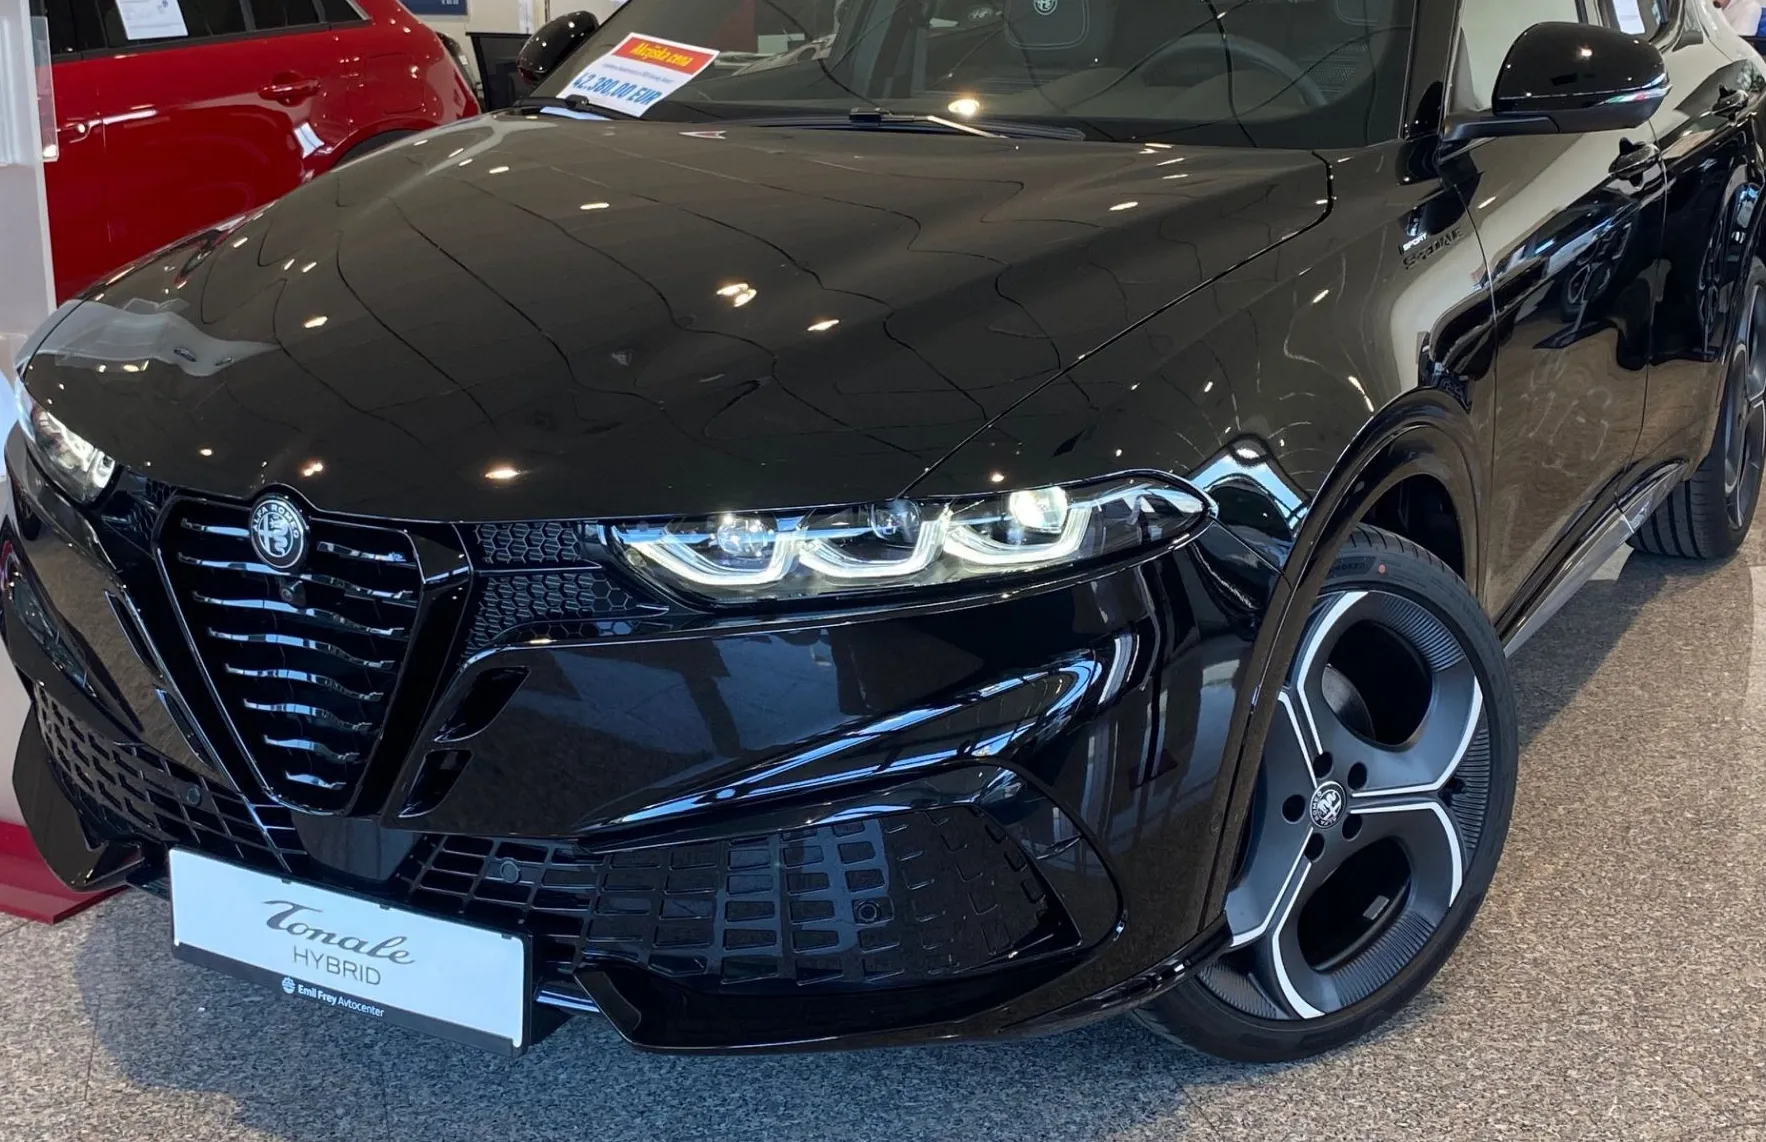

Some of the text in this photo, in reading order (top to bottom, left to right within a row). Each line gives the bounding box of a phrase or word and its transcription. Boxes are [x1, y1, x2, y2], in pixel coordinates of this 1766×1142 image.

[666, 53, 693, 67] cena
[630, 85, 662, 105] EUR
[252, 504, 299, 539] ALFA ROMEO
[263, 900, 415, 965] Tonale
[293, 945, 382, 986] HYBRID
[297, 984, 385, 1017] Emil Frey Avtocenter
